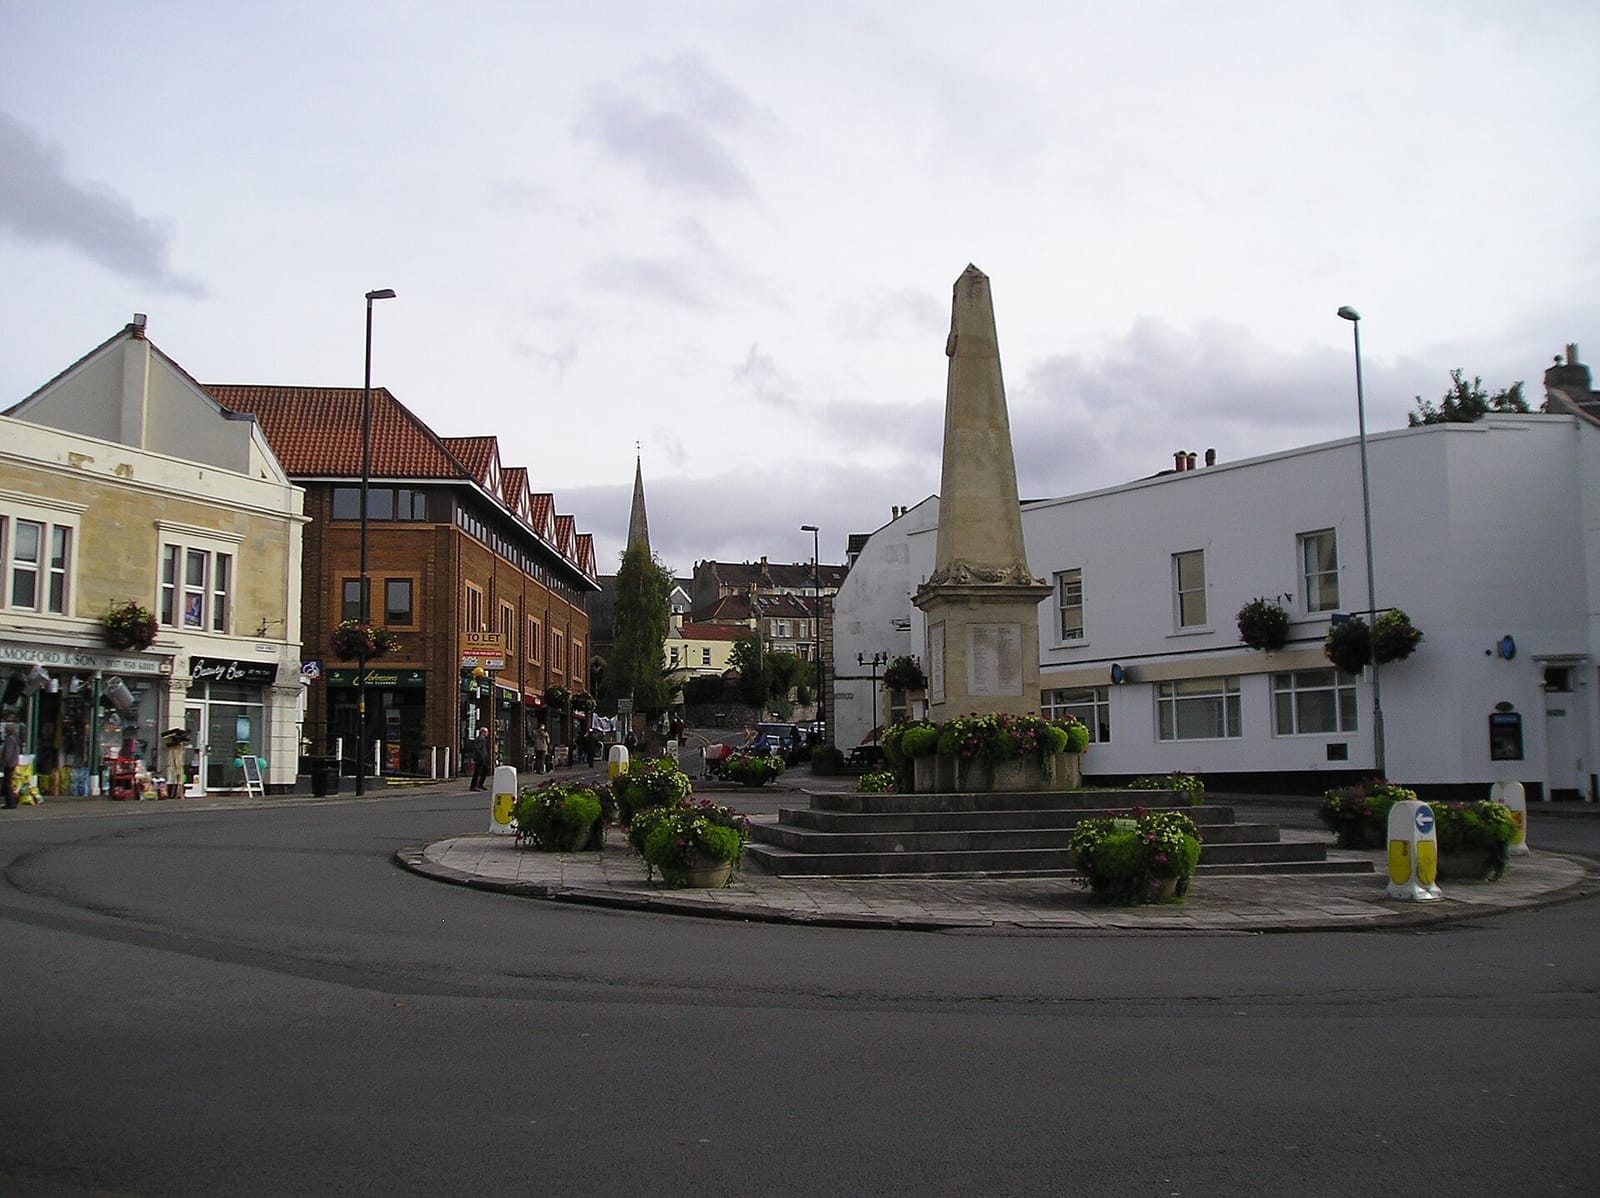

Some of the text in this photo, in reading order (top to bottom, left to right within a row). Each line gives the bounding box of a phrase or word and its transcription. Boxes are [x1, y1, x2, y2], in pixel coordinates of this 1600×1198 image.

[482, 634, 501, 642] LET
[63, 653, 71, 665] &
[72, 654, 97, 666] SON
[192, 659, 226, 680] Beauty
